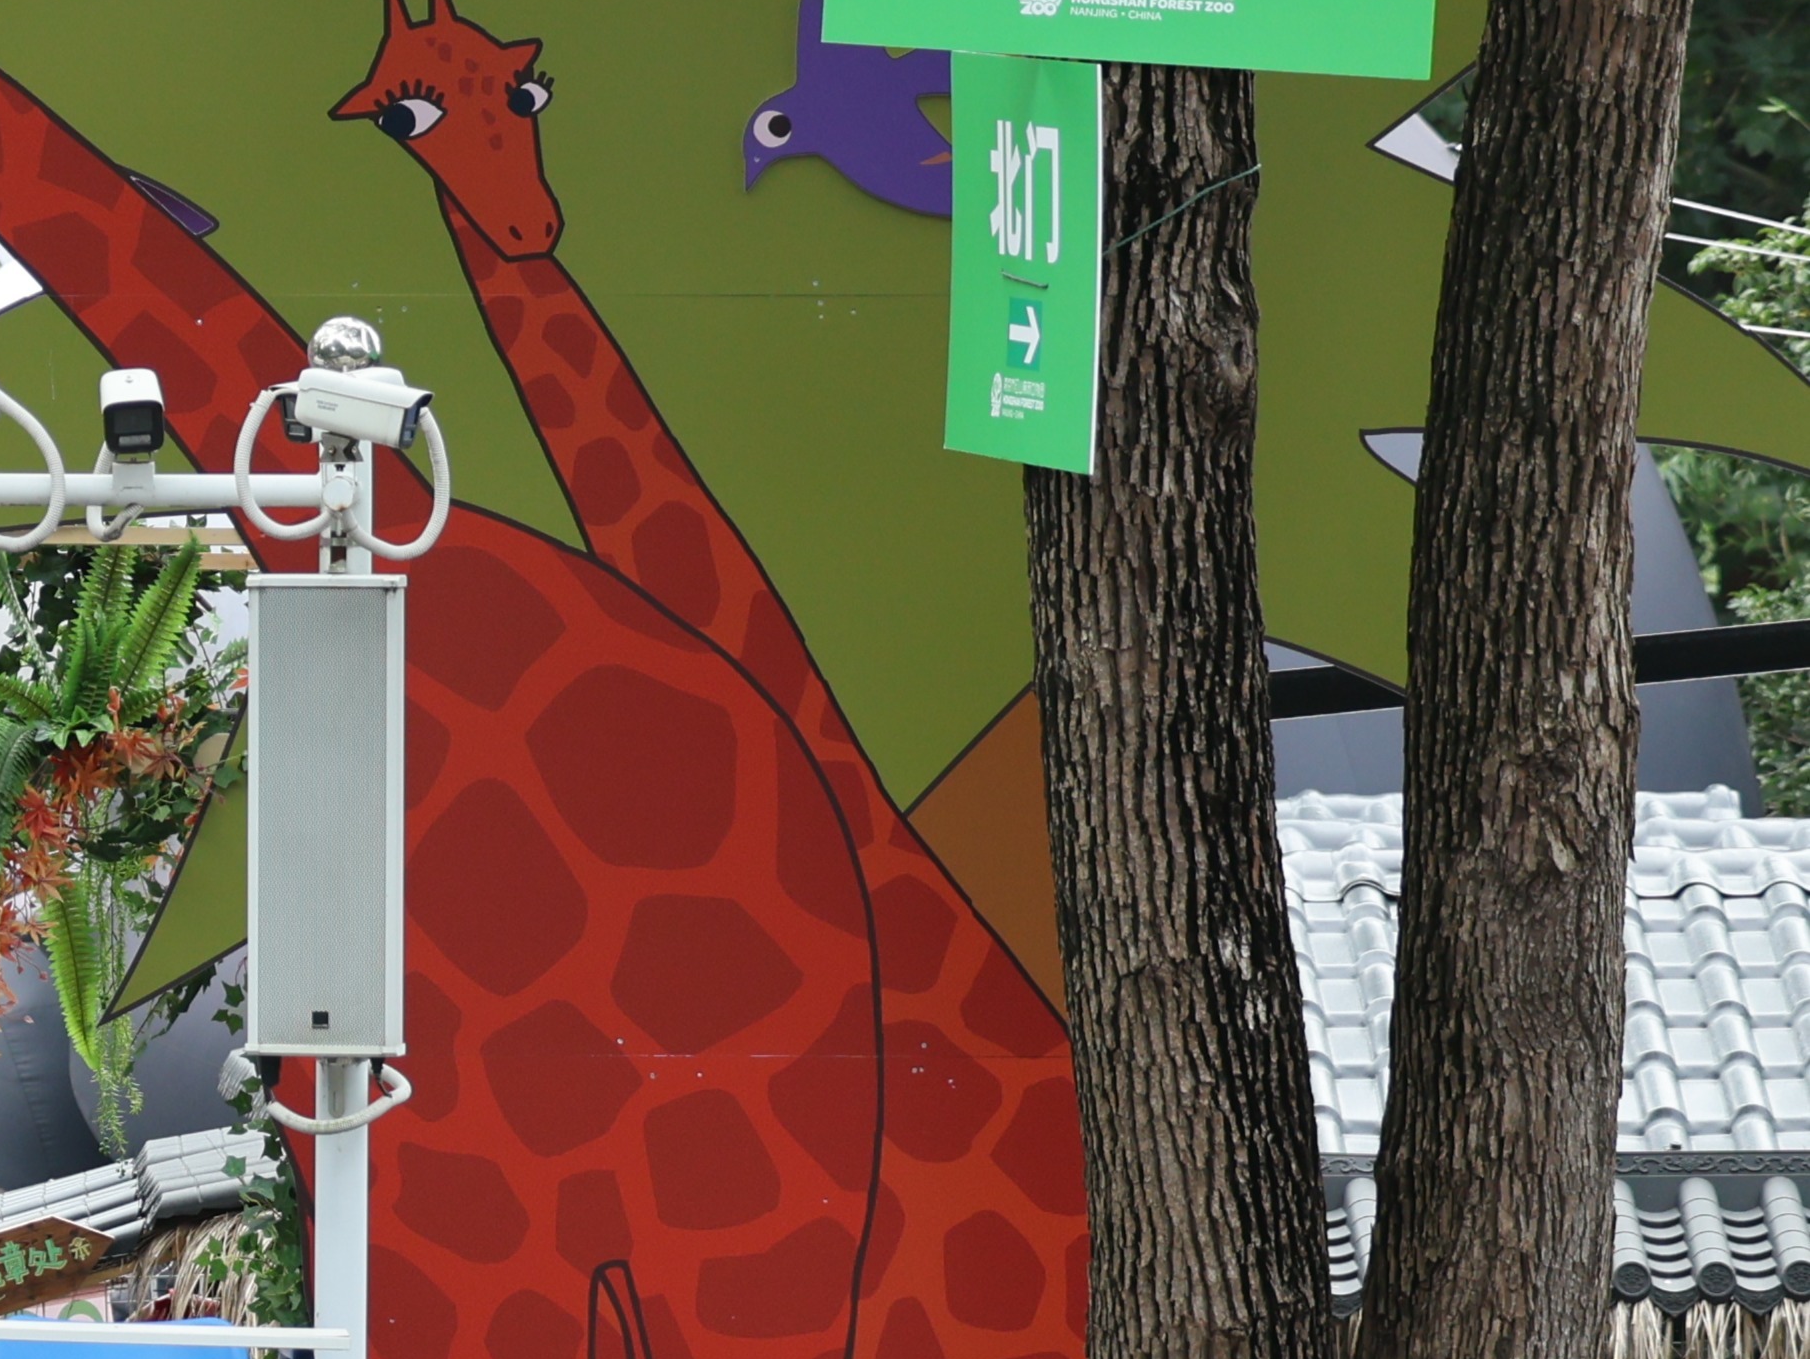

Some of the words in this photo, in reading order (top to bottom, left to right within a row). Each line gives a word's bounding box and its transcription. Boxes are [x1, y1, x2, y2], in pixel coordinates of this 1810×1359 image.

[1019, 0, 1058, 16] ZOO
[1070, 6, 1118, 19] NANJING
[1128, 10, 1162, 21] CHINA
[1204, 0, 1235, 14] ZOO
[989, 119, 1060, 264] 北门
